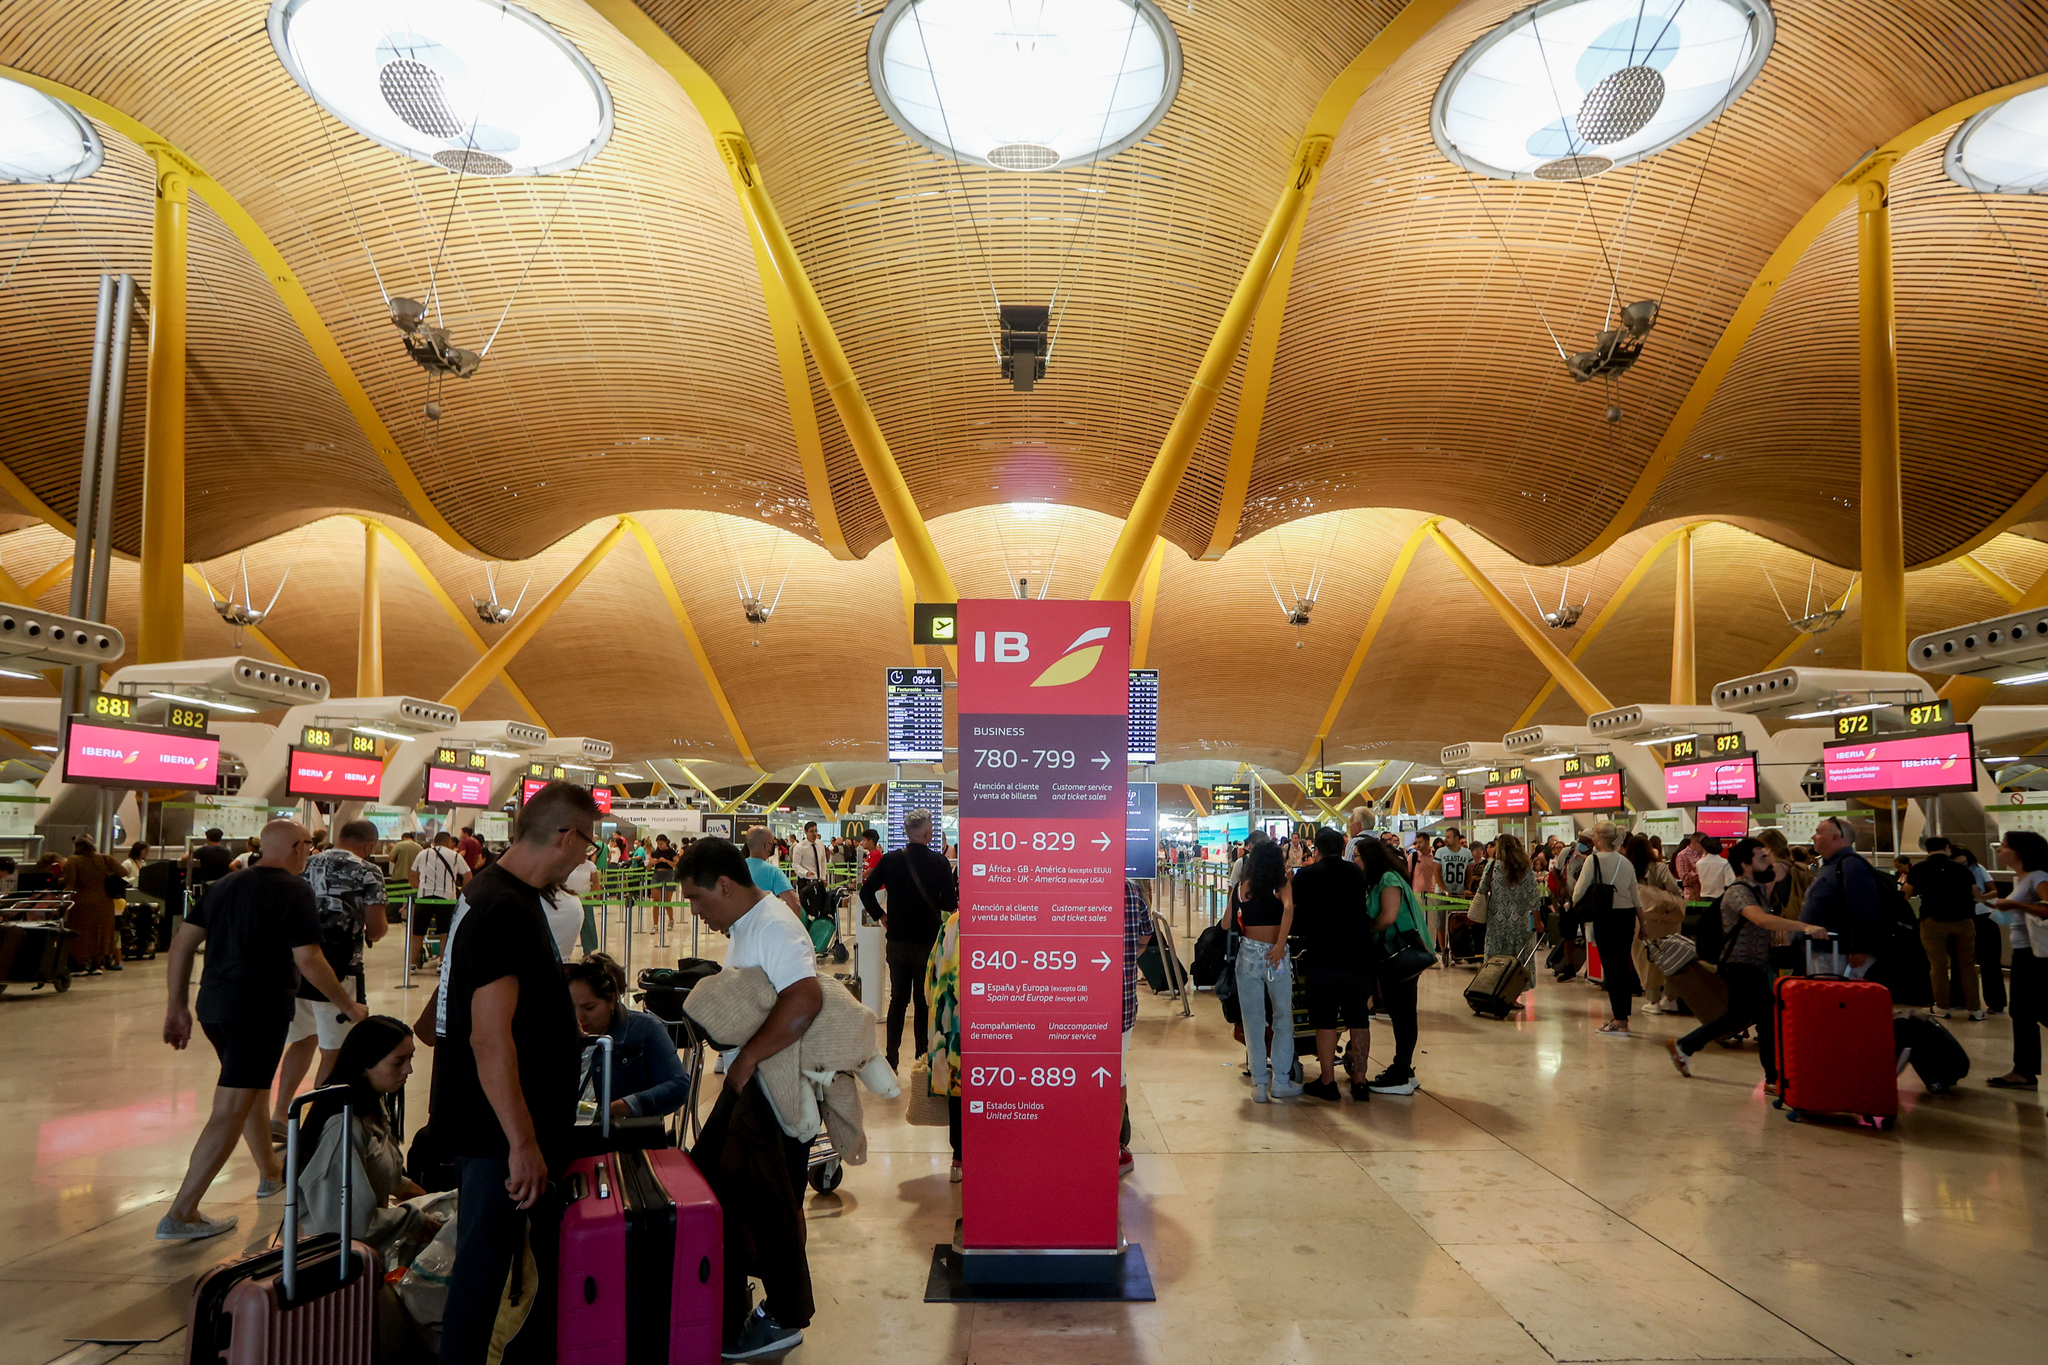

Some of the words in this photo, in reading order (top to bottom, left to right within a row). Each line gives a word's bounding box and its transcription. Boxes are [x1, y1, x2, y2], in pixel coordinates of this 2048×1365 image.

[975, 631, 1030, 662] IB
[912, 676, 936, 684] 09:44
[95, 696, 131, 717] 881
[172, 709, 204, 728] 882
[1910, 704, 1942, 725] 871
[1839, 715, 1868, 734] 872
[307, 729, 331, 746] 883
[974, 728, 1025, 736] BUSINESS
[353, 737, 374, 752] 884
[1717, 735, 1739, 751] 873
[82, 747, 123, 759] IBERIA
[1674, 741, 1692, 757] 874
[1836, 750, 1865, 759] IBERIA
[160, 754, 195, 765] IBERIA
[440, 749, 455, 764] 885
[470, 754, 485, 768] 886
[1595, 755, 1610, 768] 875
[1565, 760, 1579, 772] 876
[1901, 757, 1941, 768] IBERIA
[298, 768, 323, 777] IBERIA
[531, 764, 543, 775] 887
[553, 767, 565, 778] 888
[1510, 767, 1522, 779] 877
[1672, 769, 1691, 777] IBERIA
[345, 773, 367, 781] IBERIA
[973, 782, 1005, 790] Atención
[1052, 783, 1087, 791] Customer
[1011, 792, 1037, 800] billetes
[1127, 790, 1137, 800] ip
[989, 863, 1011, 875] África
[1018, 865, 1029, 873] GB
[1035, 865, 1066, 873] América
[1068, 867, 1092, 876] (excepto
[1094, 867, 1112, 875] EEUU)
[1445, 862, 1465, 884] 66
[1018, 875, 1029, 883] UK
[1034, 875, 1066, 883] America
[1068, 877, 1089, 885] (except
[972, 903, 1004, 911] Atención
[1014, 904, 1039, 912] cliente
[1052, 904, 1087, 912] Customer
[988, 984, 1015, 994] España
[1023, 984, 1049, 994] Europa
[1051, 985, 1076, 993] (excepto
[1077, 985, 1088, 993] GB)
[987, 994, 1009, 1003] Spain
[1027, 994, 1053, 1003] Europe
[1055, 995, 1076, 1003] (except
[971, 1022, 1036, 1032] Acompañamiento
[1049, 1022, 1108, 1032] Unaccompanied
